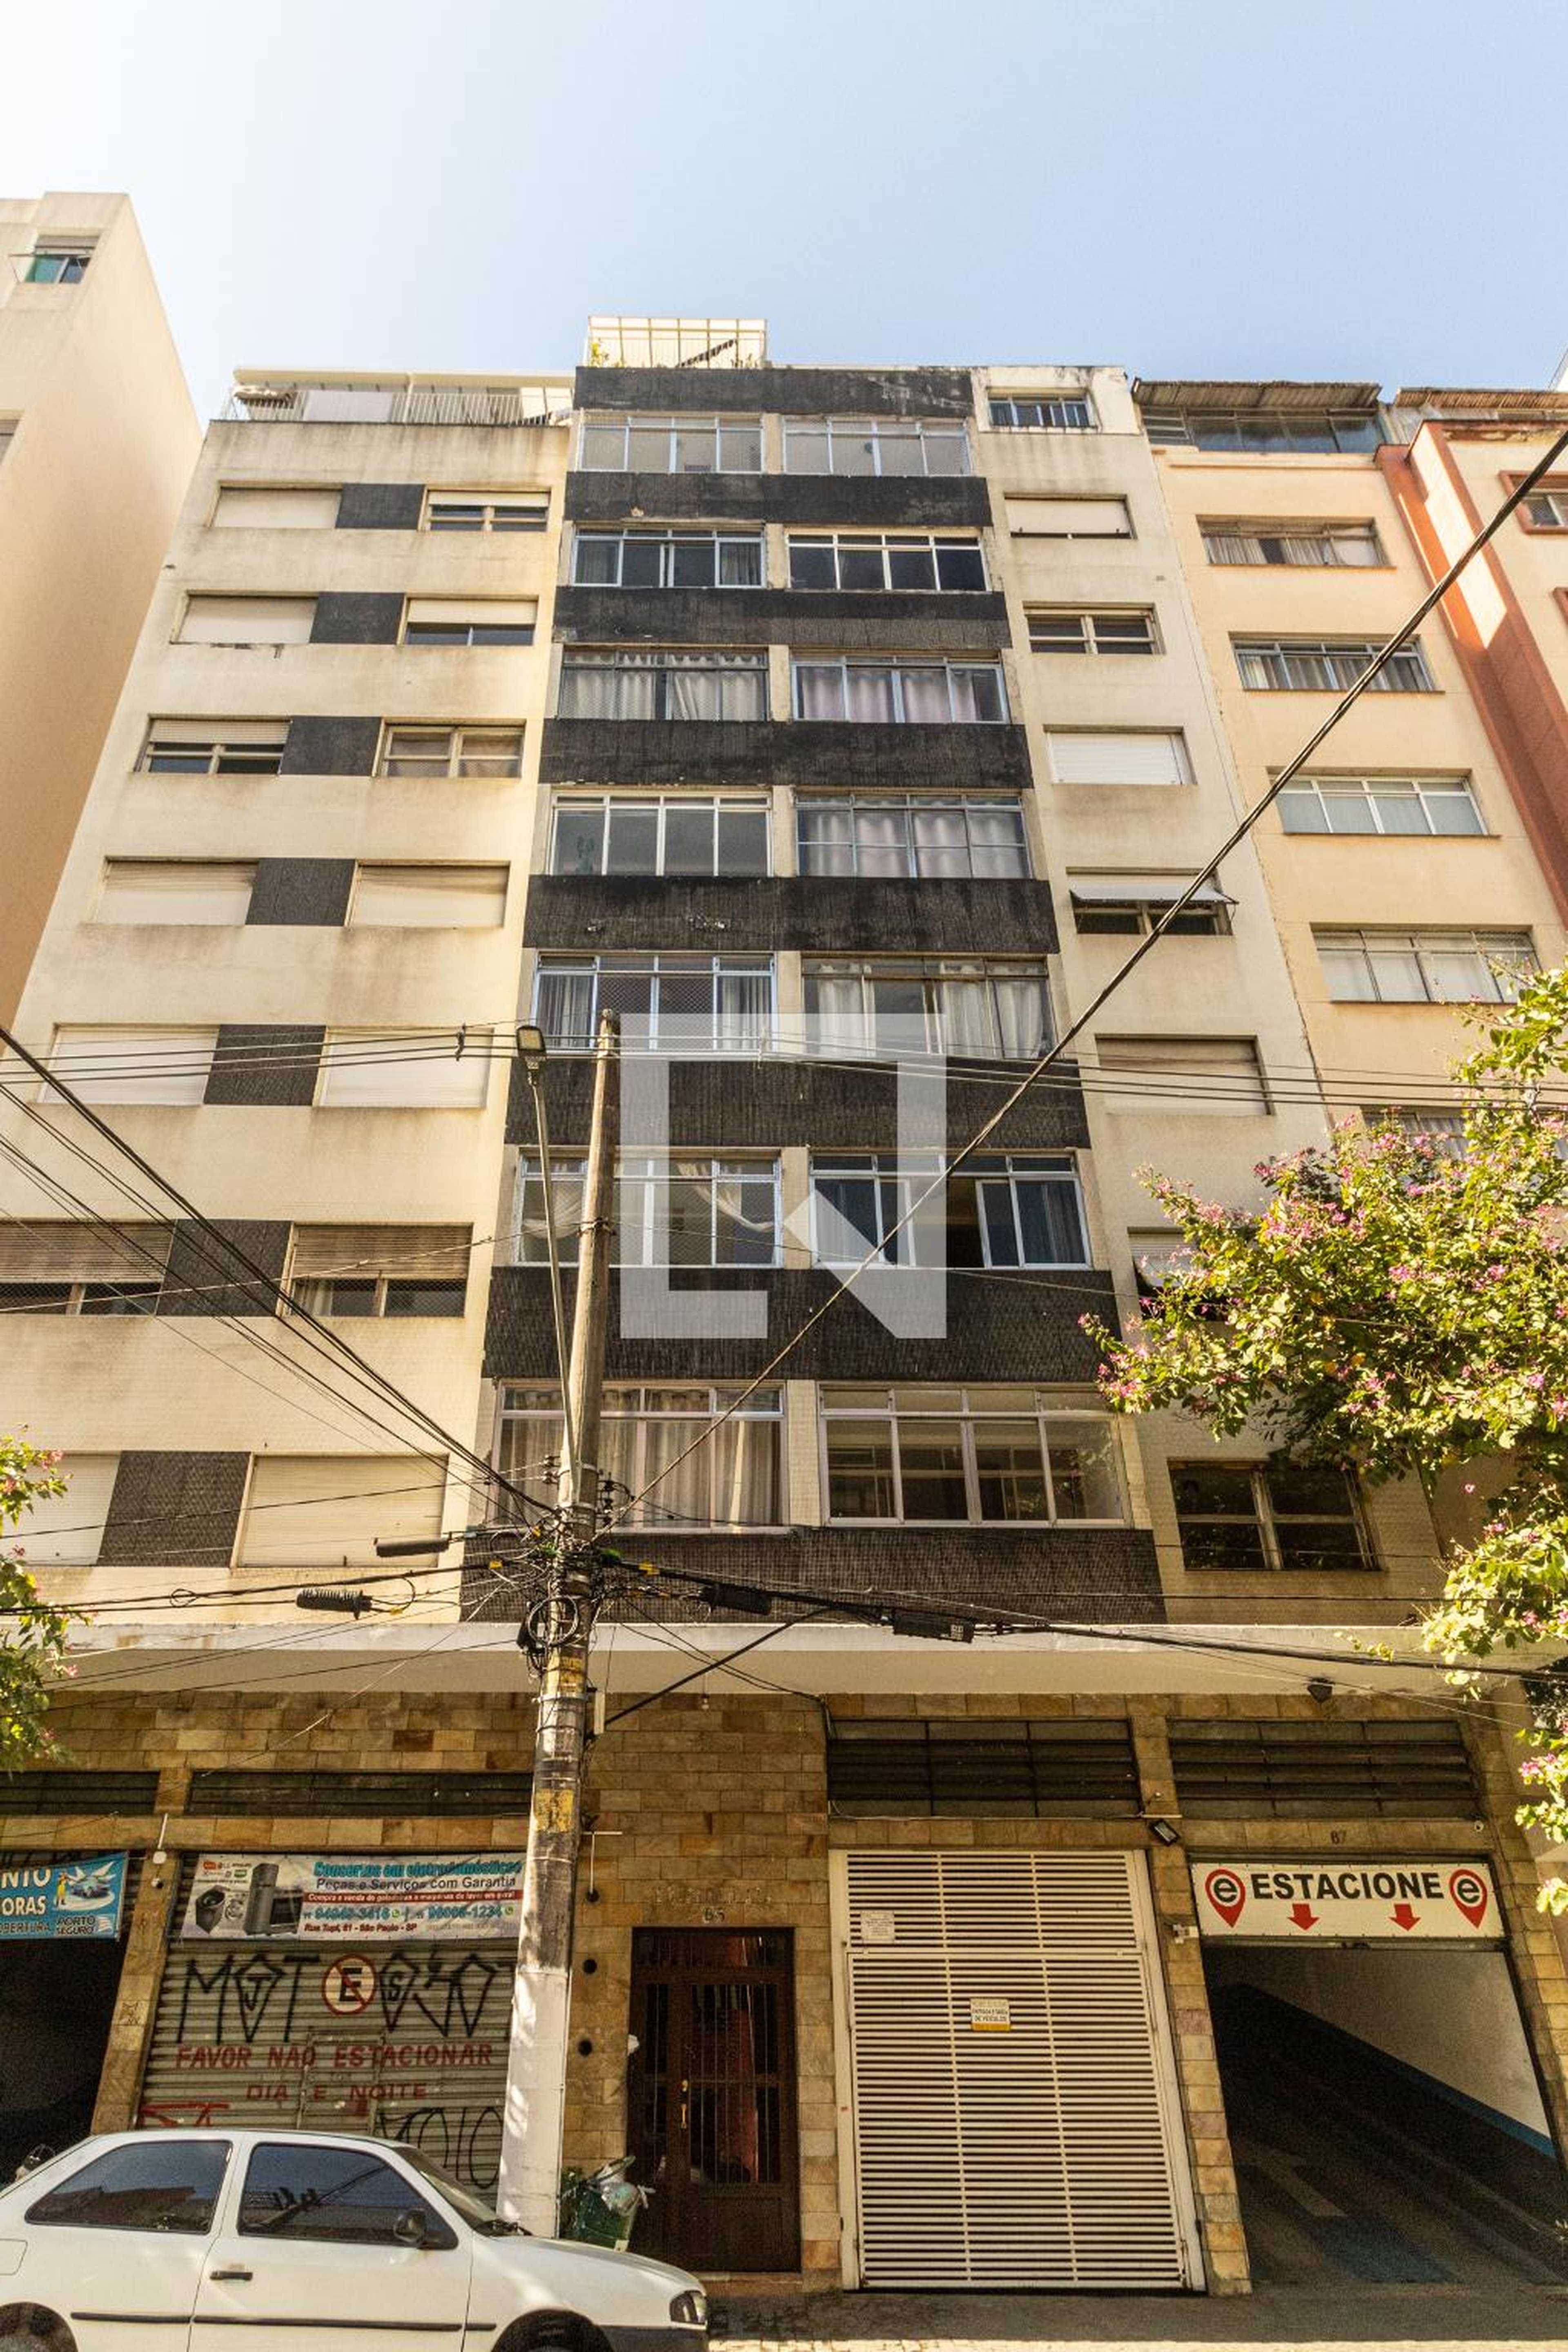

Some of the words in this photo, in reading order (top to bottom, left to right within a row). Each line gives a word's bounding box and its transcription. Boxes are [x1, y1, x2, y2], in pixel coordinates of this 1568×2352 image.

[430, 1878, 458, 1889] com
[461, 1876, 515, 1888] Garantia
[1250, 1872, 1444, 1900] ESTACIONE
[2, 1895, 46, 1915] ORAS
[175, 2045, 252, 2069] FAVOR
[334, 2043, 492, 2068] ESTACIONAR
[246, 2083, 288, 2100] DIA
[313, 2085, 327, 2100] E
[350, 2083, 427, 2100] NOITE
